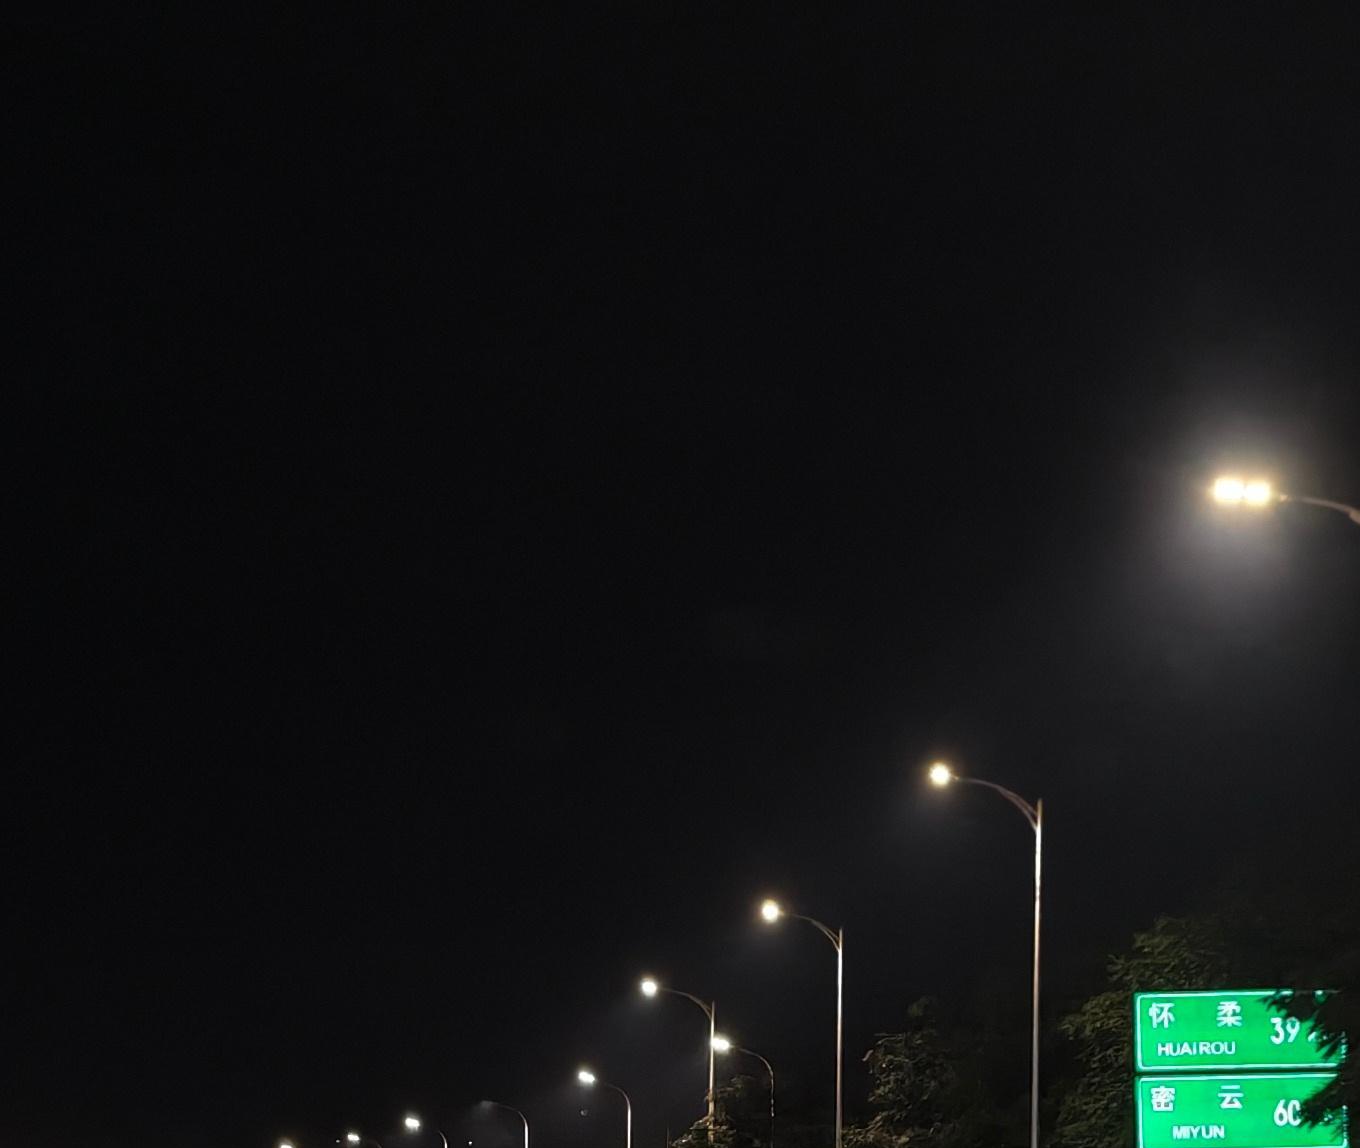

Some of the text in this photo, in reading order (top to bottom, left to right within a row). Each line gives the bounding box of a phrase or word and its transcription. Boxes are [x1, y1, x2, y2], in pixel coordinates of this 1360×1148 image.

[1148, 1001, 1242, 1028] 怀柔
[1270, 1017, 1300, 1044] 39
[1150, 1085, 1243, 1112] 密云
[1172, 1125, 1225, 1140] MIYUN
